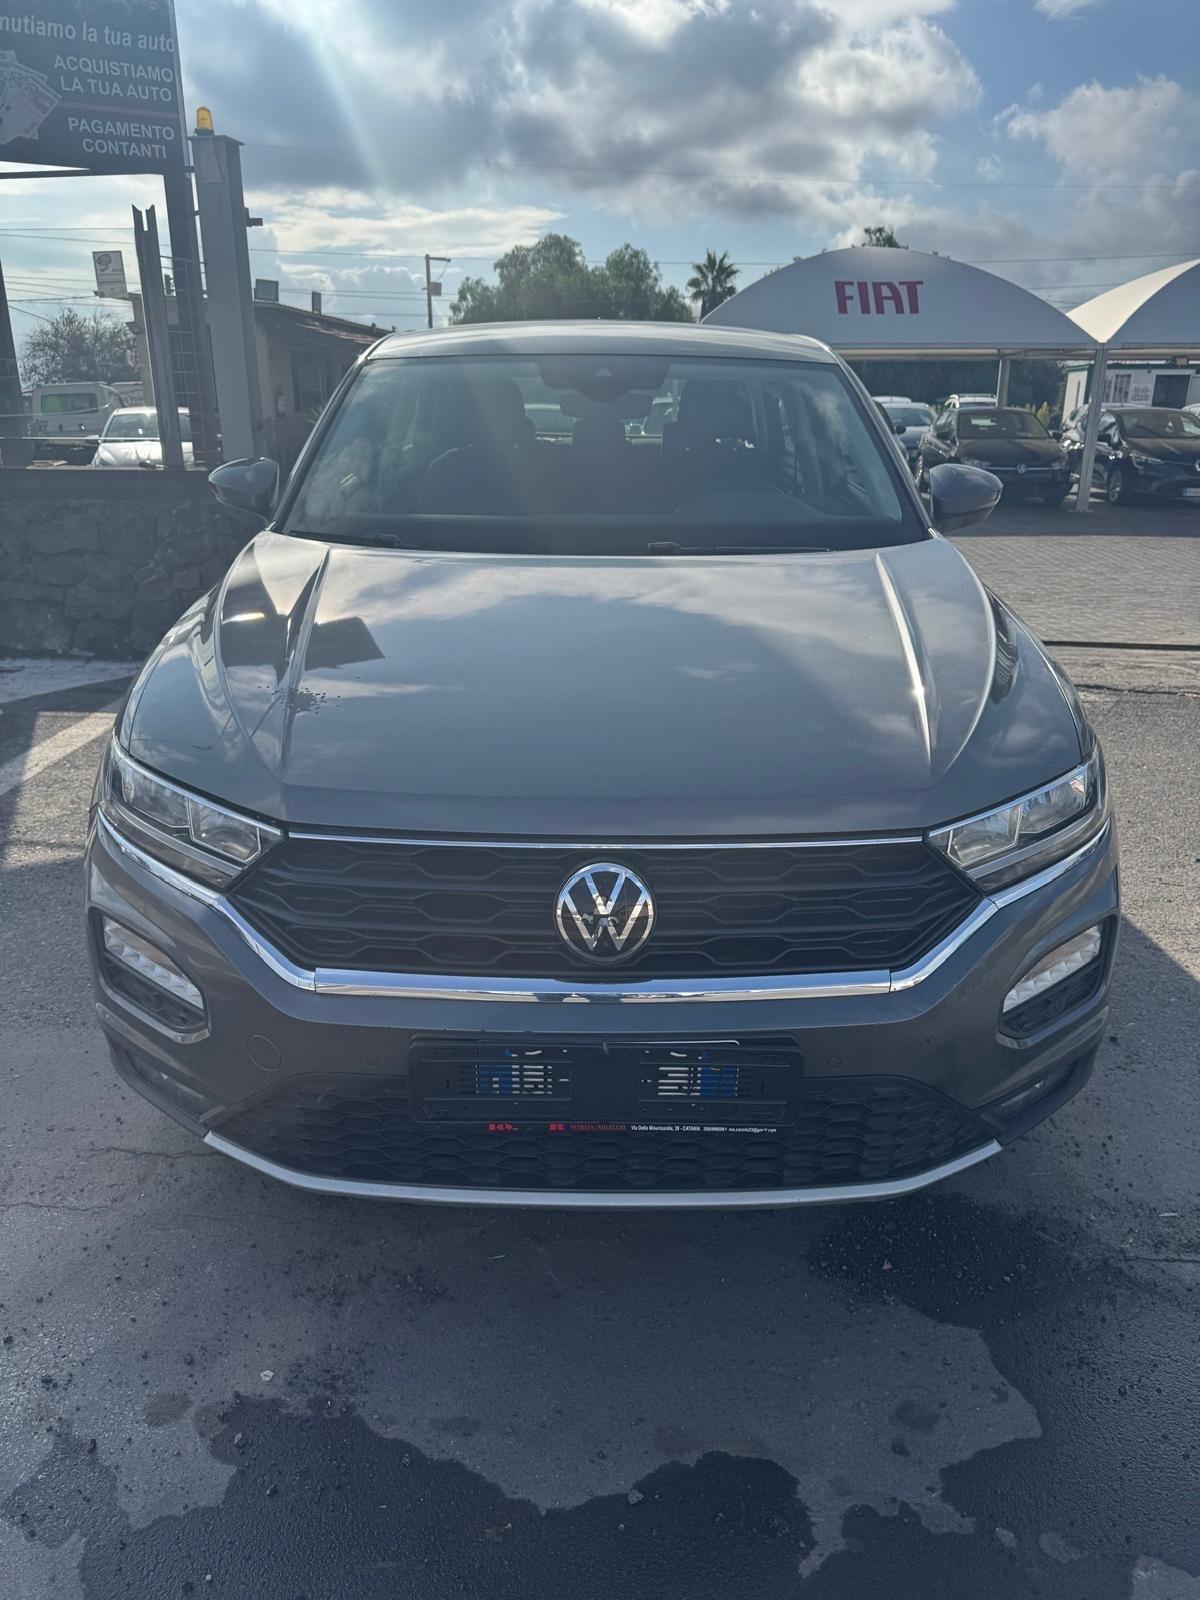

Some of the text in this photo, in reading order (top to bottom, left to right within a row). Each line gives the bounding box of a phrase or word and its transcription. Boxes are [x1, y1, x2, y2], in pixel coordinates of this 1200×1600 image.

[83, 22, 98, 44] la
[104, 27, 132, 47] tua
[138, 34, 175, 53] auto
[54, 54, 174, 83] ACQUISTIAMO
[60, 75, 172, 102] LA TUA AUTO
[68, 116, 175, 141] PAGAMENTO
[82, 138, 167, 159] CONTANTI
[834, 280, 924, 315] FIAT
